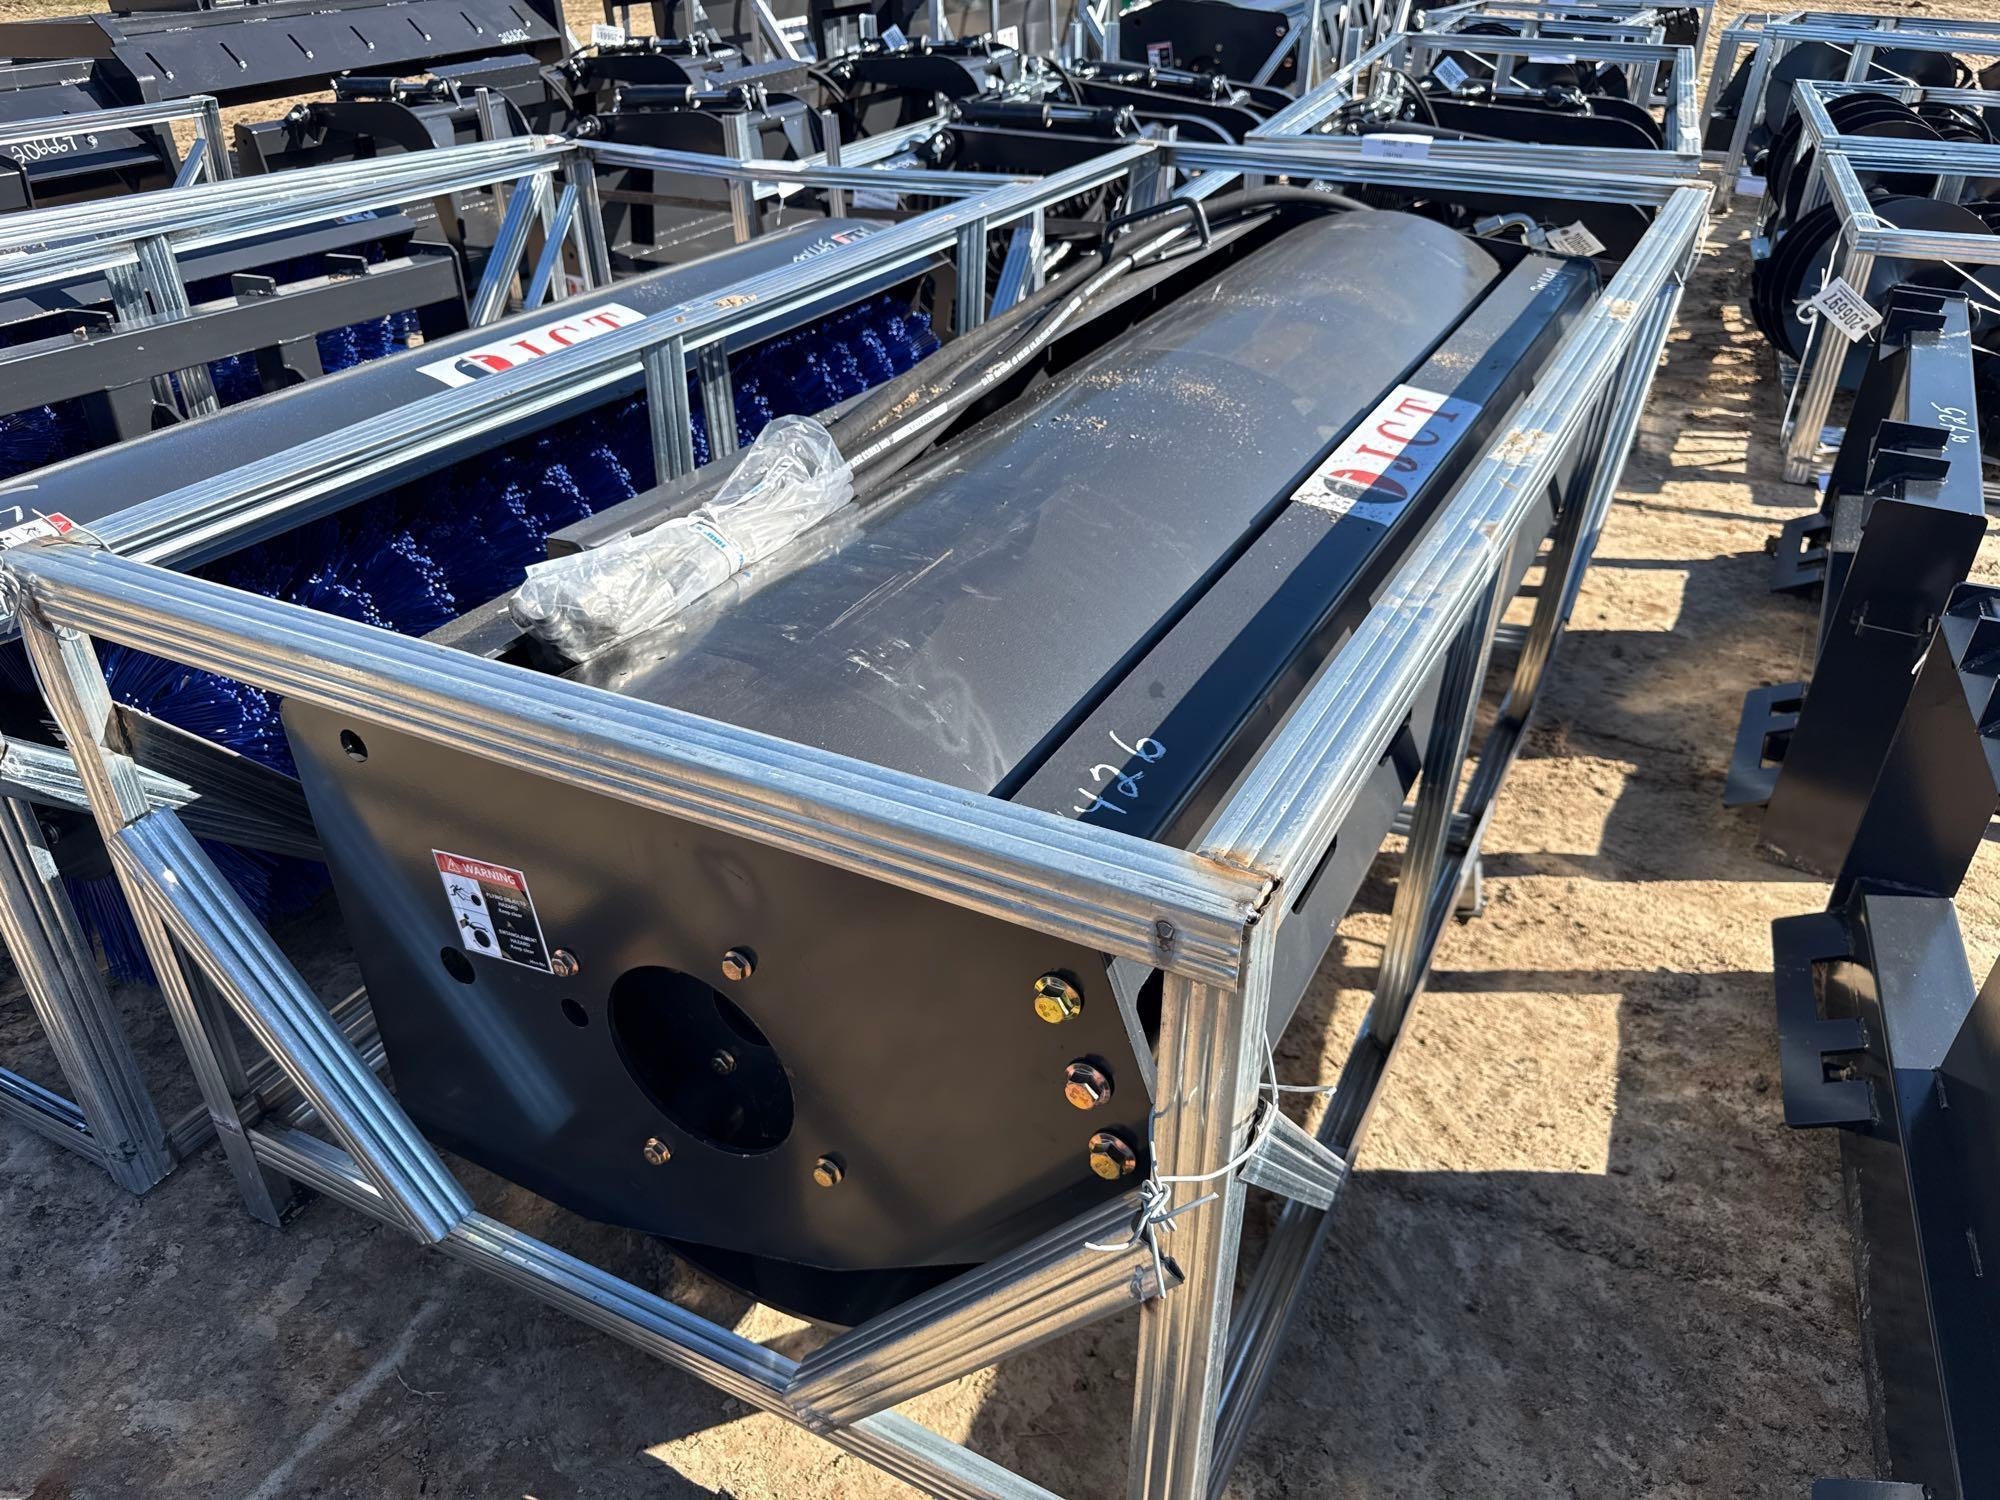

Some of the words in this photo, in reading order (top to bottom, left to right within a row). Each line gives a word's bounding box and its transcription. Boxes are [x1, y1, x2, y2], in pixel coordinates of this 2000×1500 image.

[11, 136, 78, 164] 206667
[1823, 292, 1864, 330] 206697
[1356, 397, 1460, 472] JCT
[462, 863, 516, 884] WARNING
